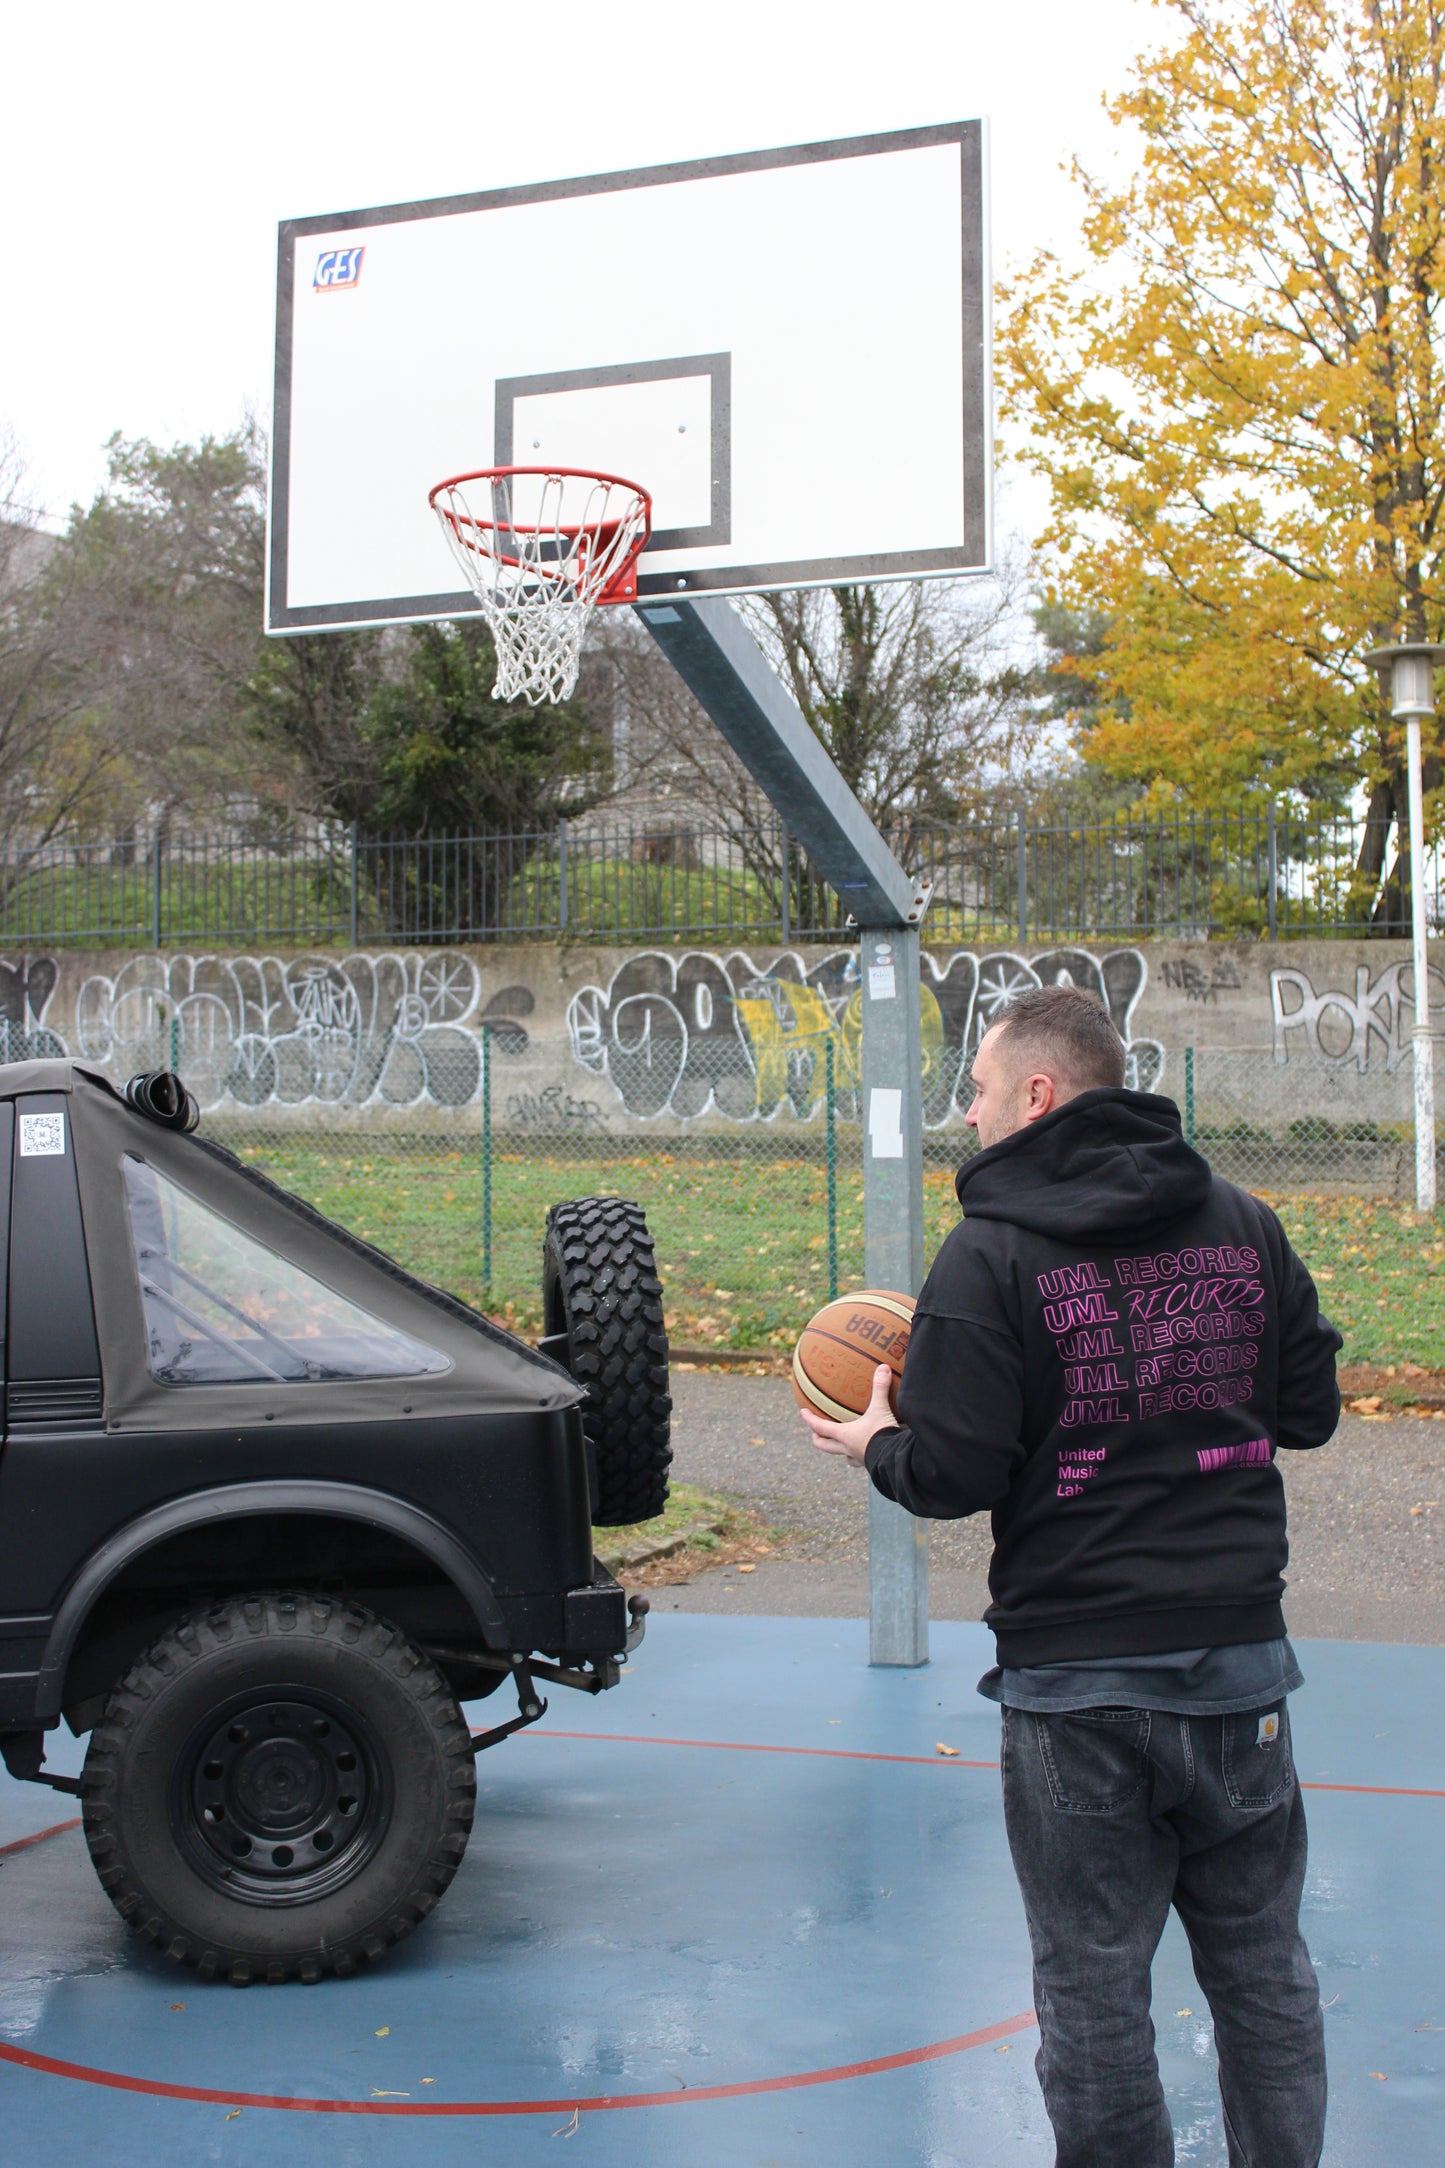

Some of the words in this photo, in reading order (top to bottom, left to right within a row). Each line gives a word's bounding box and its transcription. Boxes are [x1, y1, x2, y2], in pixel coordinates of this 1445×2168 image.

[315, 248, 363, 287] GES
[1037, 1262, 1111, 1299] UML
[1114, 1246, 1260, 1285] RECORDS
[1043, 1293, 1119, 1333] UML
[1122, 1277, 1265, 1322] RECORDS
[845, 1313, 897, 1351] FIBA
[1056, 1327, 1124, 1361] UML
[1130, 1310, 1265, 1352] RECORDS
[1064, 1362, 1129, 1395] UML
[1135, 1342, 1258, 1387] RECORDS
[1059, 1398, 1129, 1428] UML
[1139, 1375, 1253, 1420] RECORDS
[1058, 1447, 1106, 1463] United
[1058, 1465, 1099, 1480] Music
[1056, 1483, 1085, 1497] Lab
